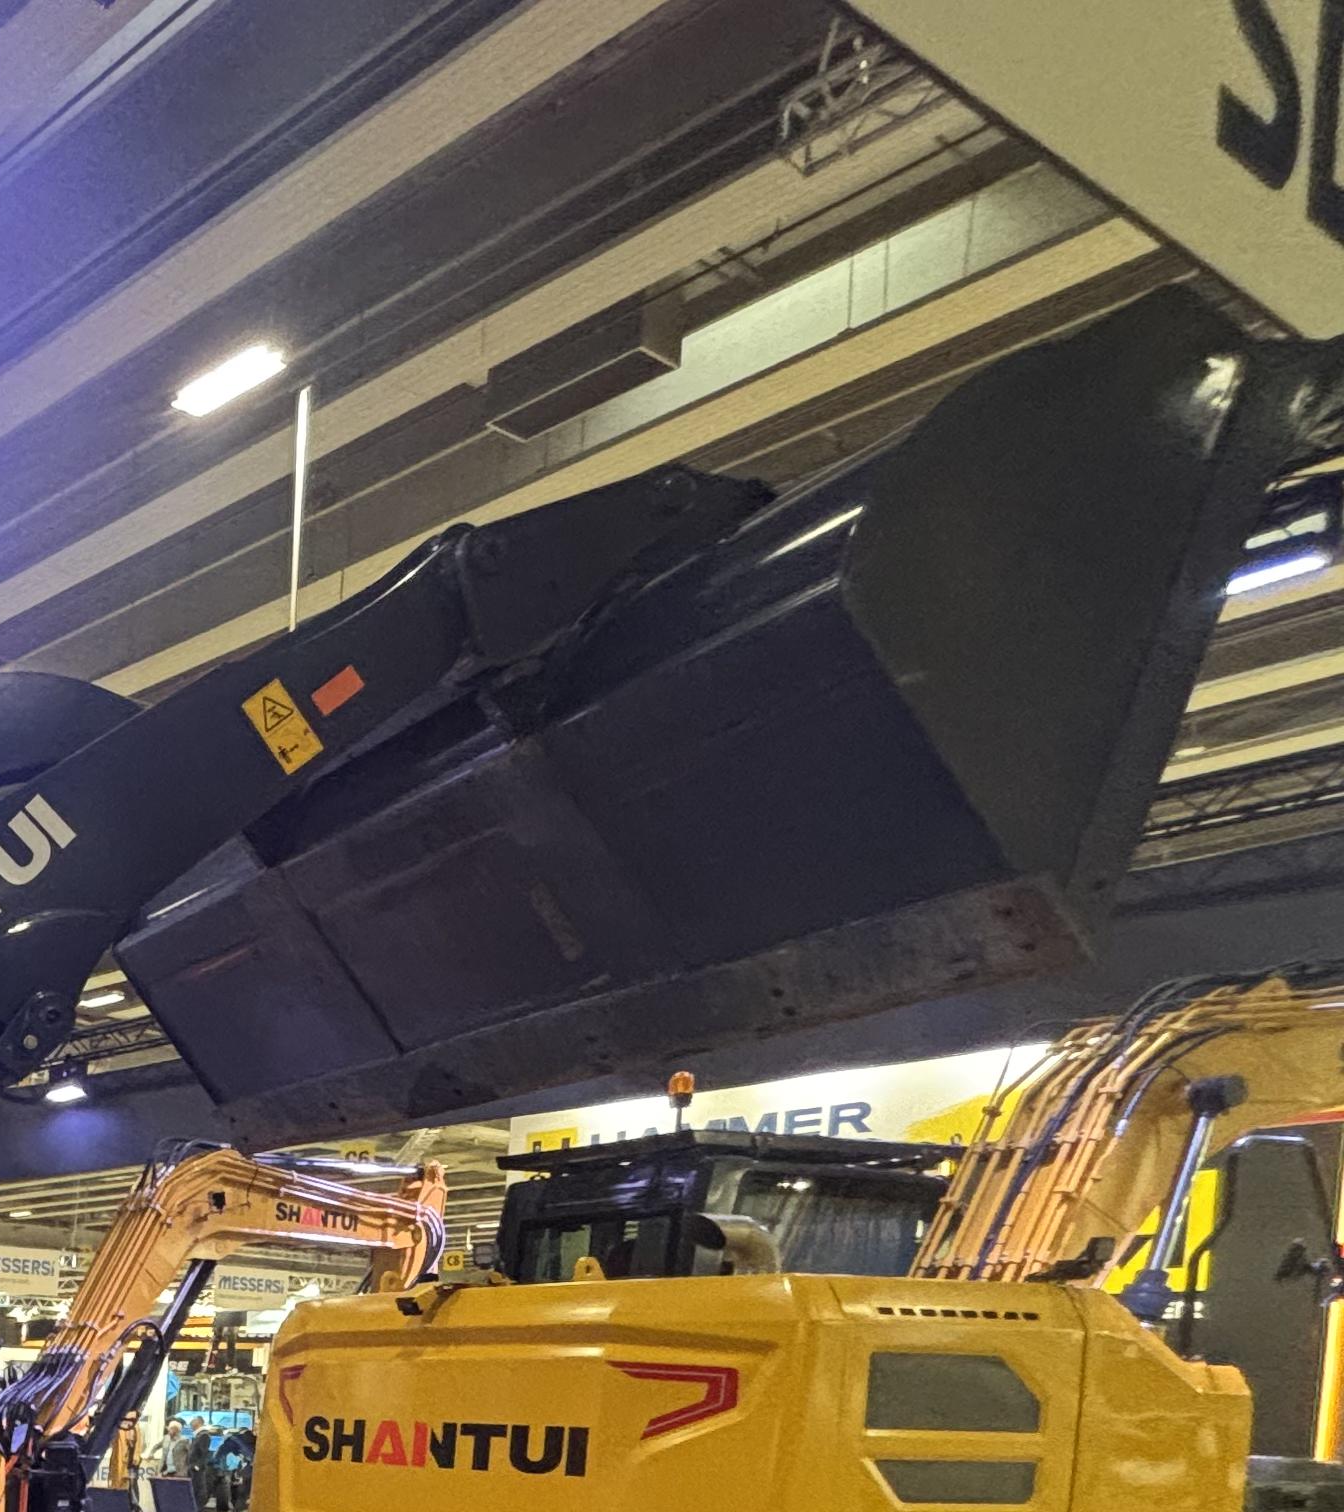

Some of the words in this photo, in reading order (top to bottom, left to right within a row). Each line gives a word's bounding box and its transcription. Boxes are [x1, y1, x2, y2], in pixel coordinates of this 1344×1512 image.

[590, 1101, 872, 1146] MER
[275, 1202, 360, 1232] SHANTUI
[302, 1416, 590, 1477] SHANTUI
